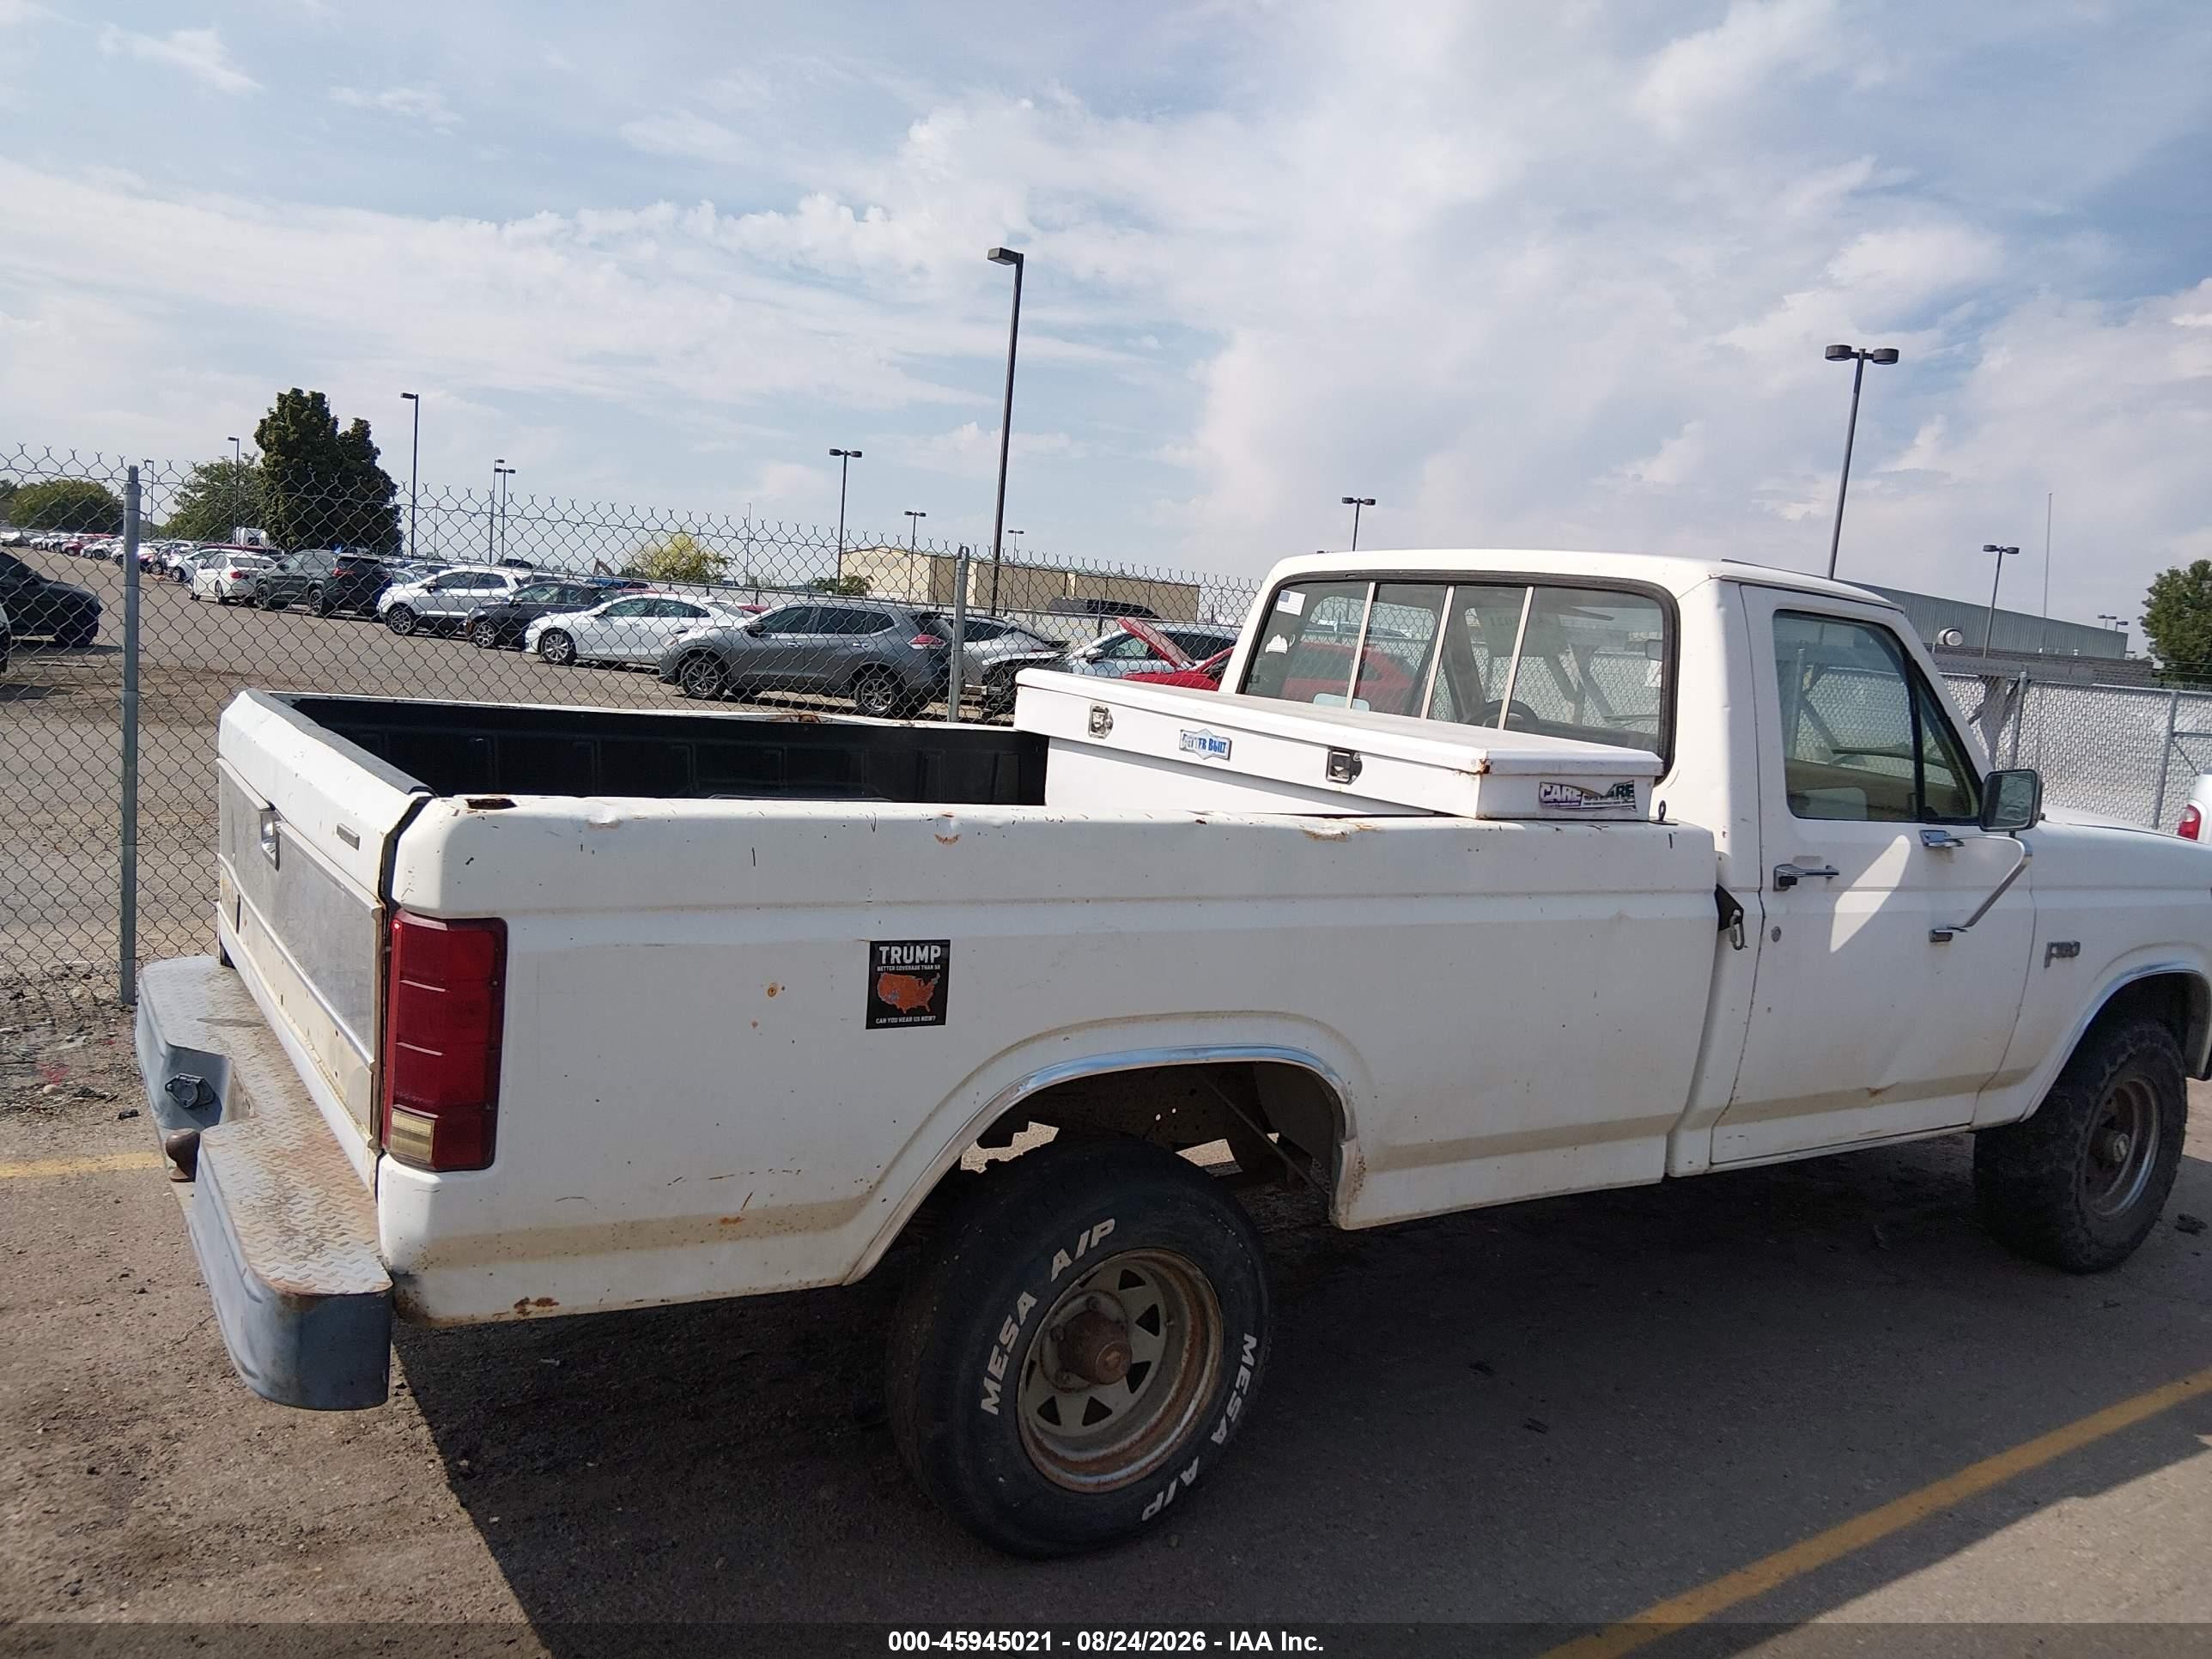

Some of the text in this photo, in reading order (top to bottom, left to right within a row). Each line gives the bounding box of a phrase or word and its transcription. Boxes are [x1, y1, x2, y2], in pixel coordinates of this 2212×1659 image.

[1540, 783, 1583, 802] CARE
[878, 945, 941, 964] TRUMP
[981, 1218, 1115, 1415] MESA A/P
[1142, 1332, 1257, 1521] MESA A/P
